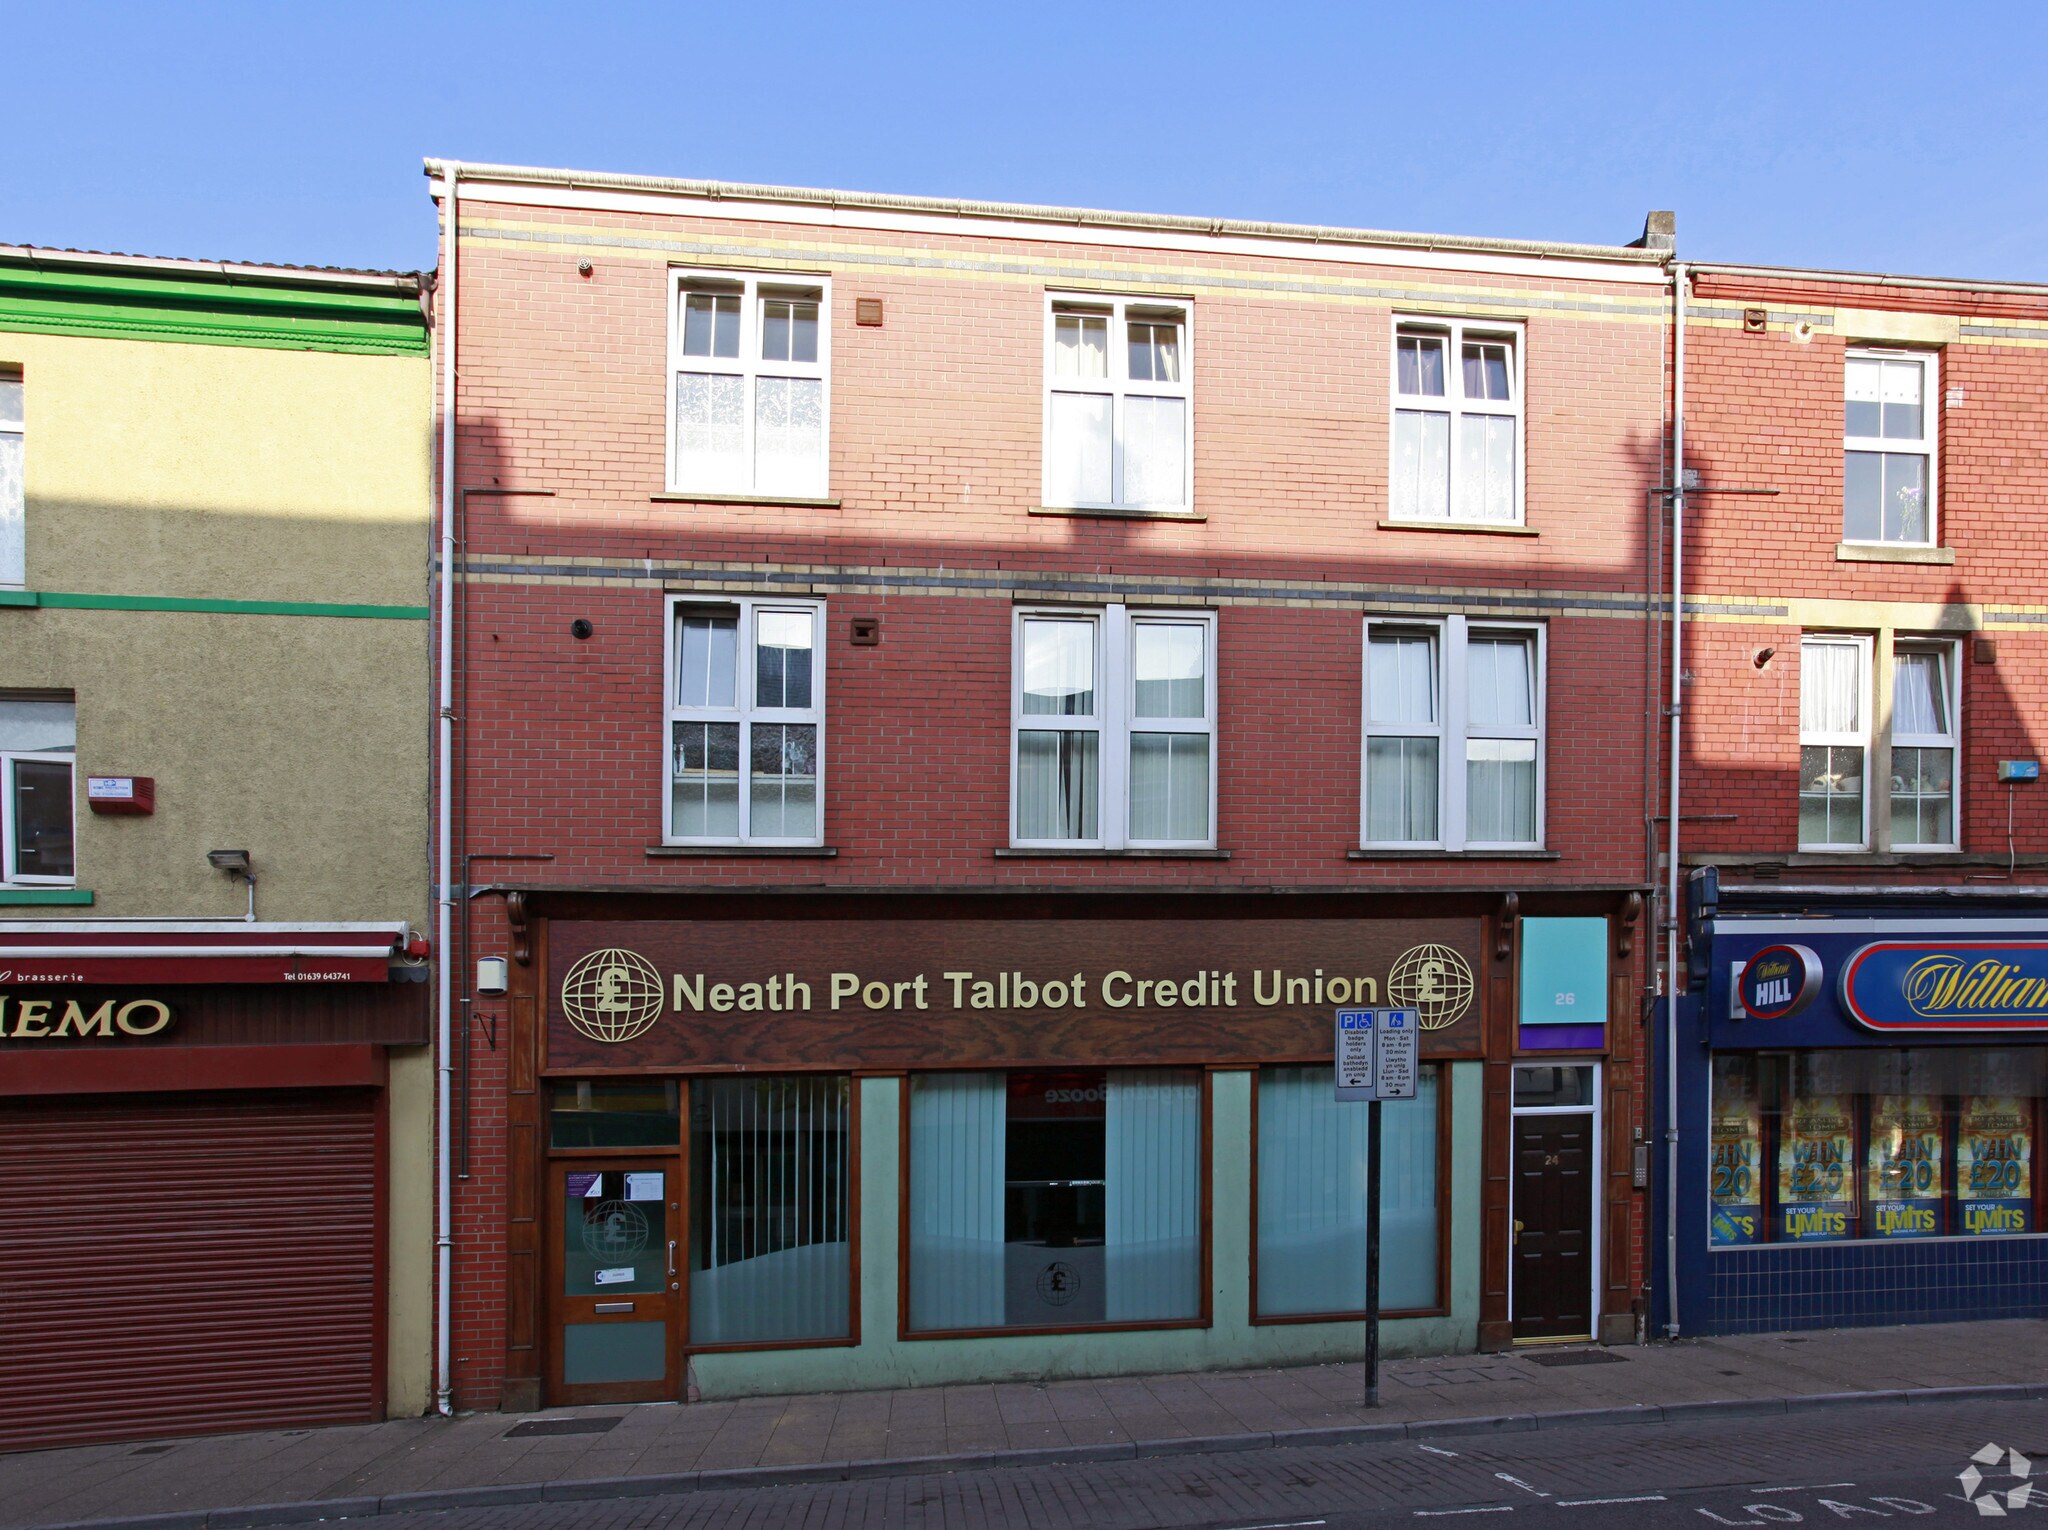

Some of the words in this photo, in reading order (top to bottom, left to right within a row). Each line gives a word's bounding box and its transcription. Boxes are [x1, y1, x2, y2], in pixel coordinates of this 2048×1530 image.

[17, 973, 84, 982] brasserie
[283, 972, 296, 981] Tel
[297, 972, 322, 981] 01639
[323, 972, 351, 981] 643741
[1756, 961, 1790, 980] William
[673, 973, 811, 1011] Neath
[831, 972, 928, 1010] Port
[944, 971, 1086, 1009] Talbot
[1102, 970, 1237, 1008] Credit
[1253, 969, 1377, 1005] Union
[1555, 992, 1576, 1005] 26
[1755, 978, 1792, 1006] HILL
[1545, 1154, 1559, 1165] 24
[1792, 1137, 1844, 1163] WIN
[1970, 1136, 2023, 1160] WIN
[1790, 1161, 1844, 1193] £20
[1879, 1159, 1933, 1190] £20
[1969, 1159, 2022, 1190] £20
[1785, 1208, 1846, 1238] LIMITS
[1876, 1204, 1936, 1235] LIMITS
[1965, 1204, 2025, 1234] LIMITS
